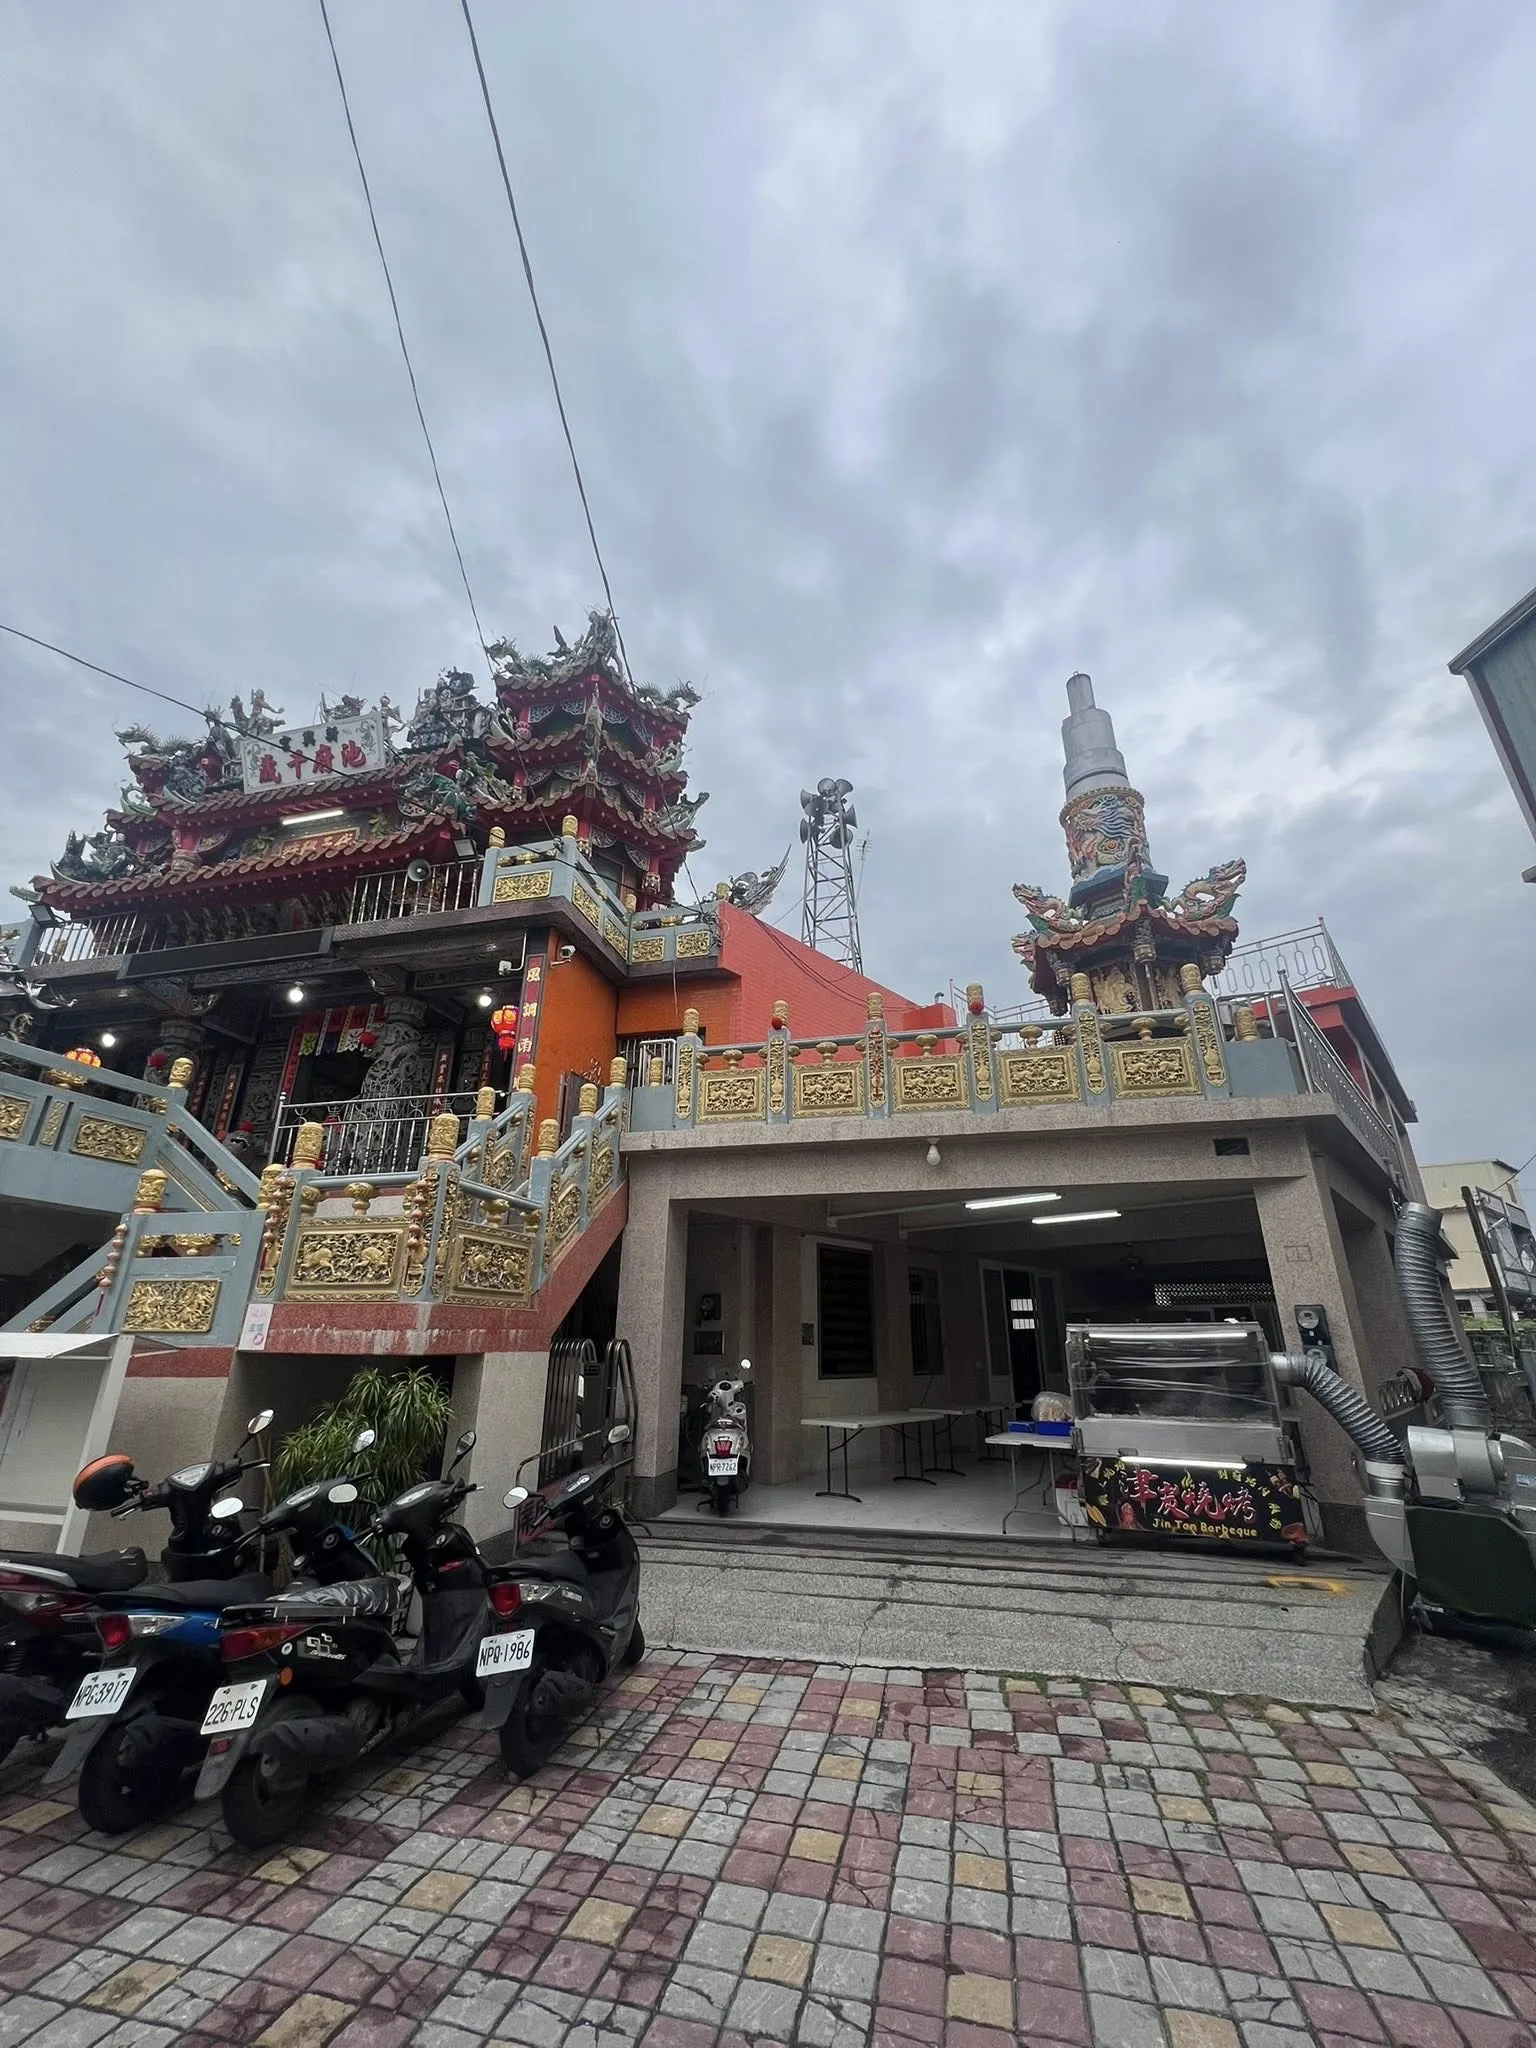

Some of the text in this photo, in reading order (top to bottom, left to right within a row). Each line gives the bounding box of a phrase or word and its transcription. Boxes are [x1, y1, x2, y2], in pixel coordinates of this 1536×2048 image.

[1152, 1517, 1258, 1538] Jin Tan Barbeque
